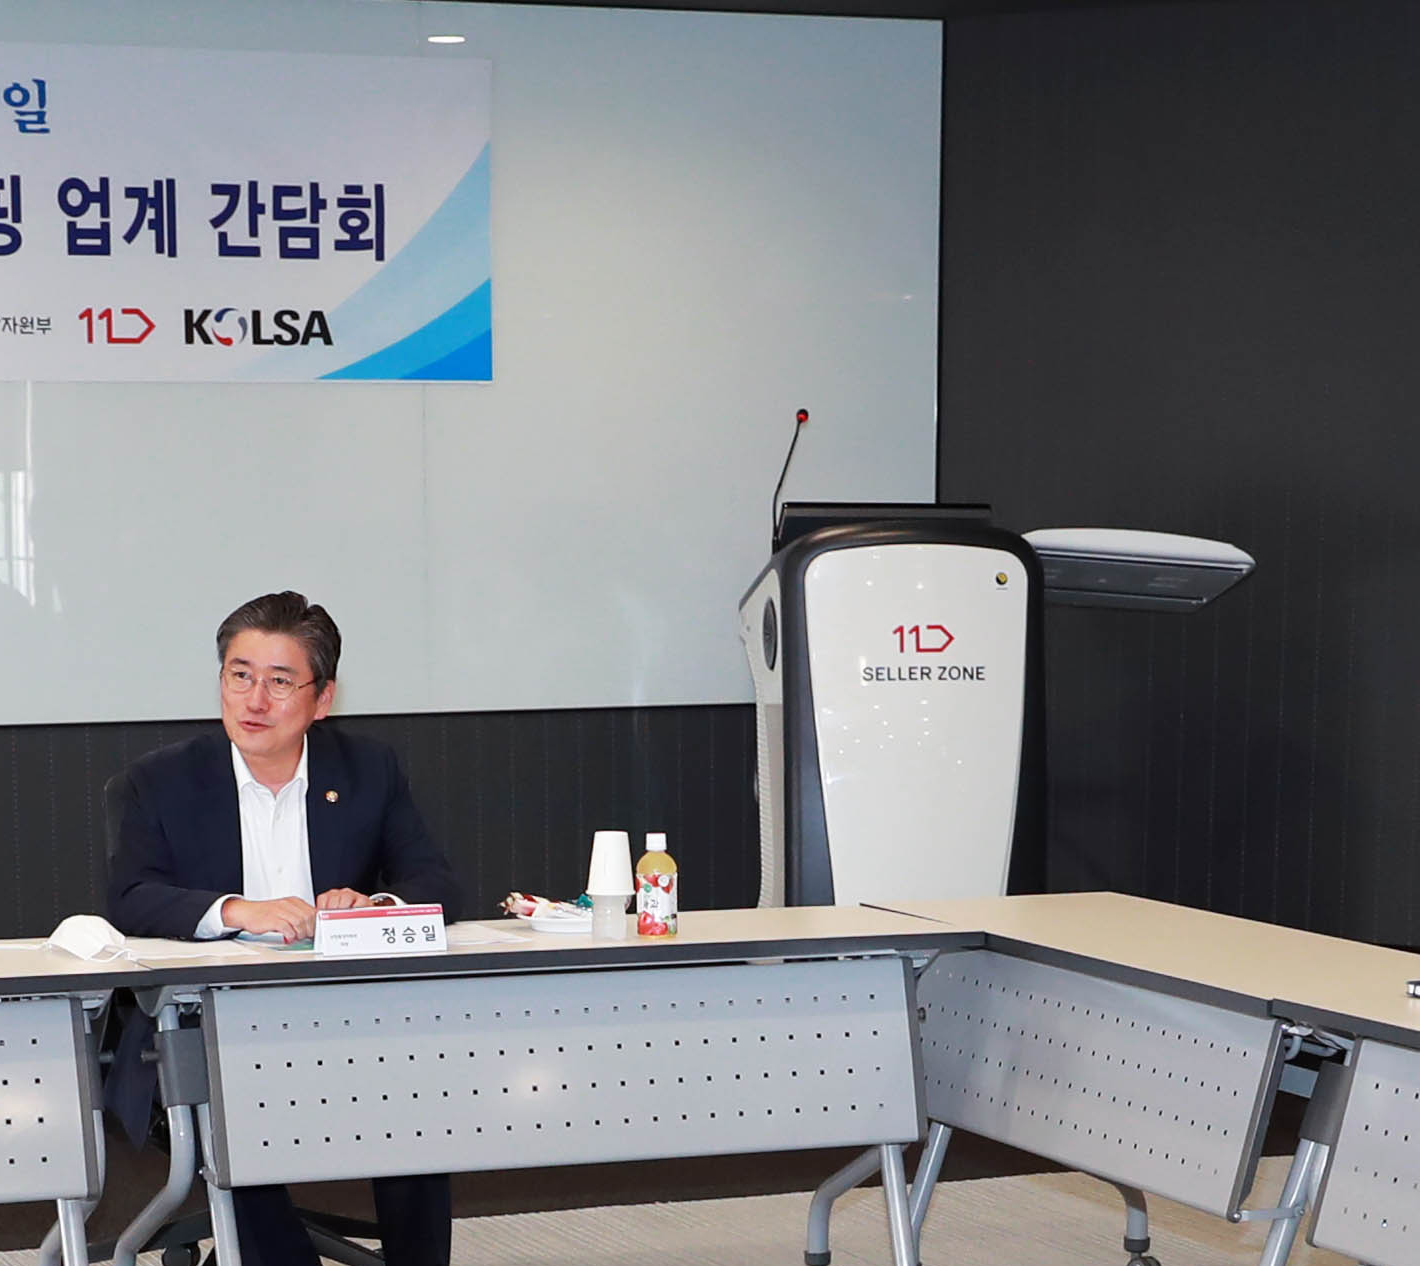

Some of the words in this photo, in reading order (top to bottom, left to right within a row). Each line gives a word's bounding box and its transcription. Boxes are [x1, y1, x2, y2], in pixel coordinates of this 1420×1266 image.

[58, 177, 177, 258] 업계
[209, 180, 385, 261] 간담회
[862, 666, 931, 682] SELLER
[937, 666, 986, 681] ZONE
[381, 925, 437, 944] 정승일
